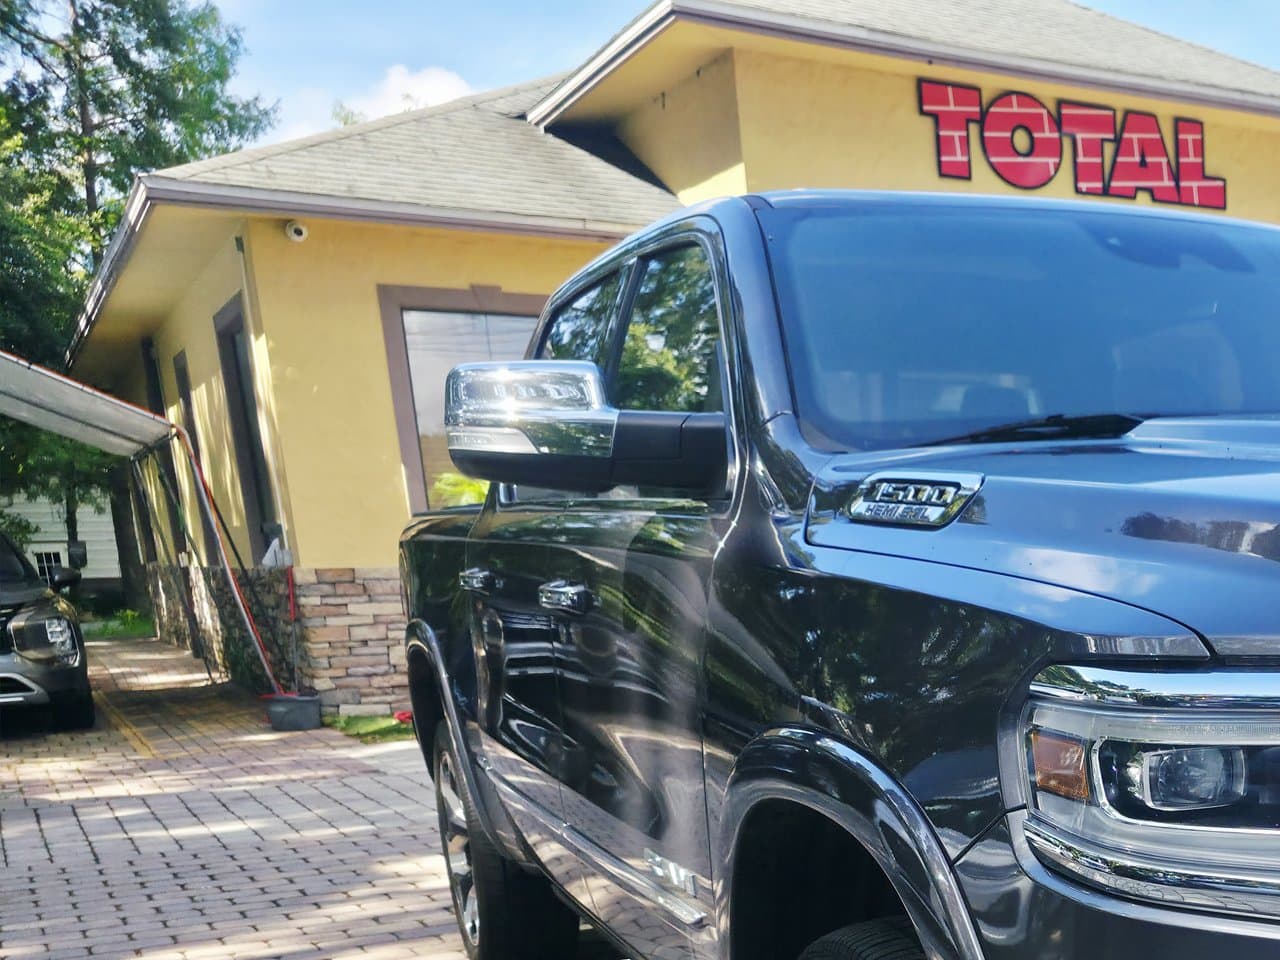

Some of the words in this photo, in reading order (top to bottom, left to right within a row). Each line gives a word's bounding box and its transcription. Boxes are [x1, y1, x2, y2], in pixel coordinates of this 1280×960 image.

[917, 78, 1226, 209] TOTAL
[873, 482, 957, 504] 1500
[865, 503, 899, 519] HEMI
